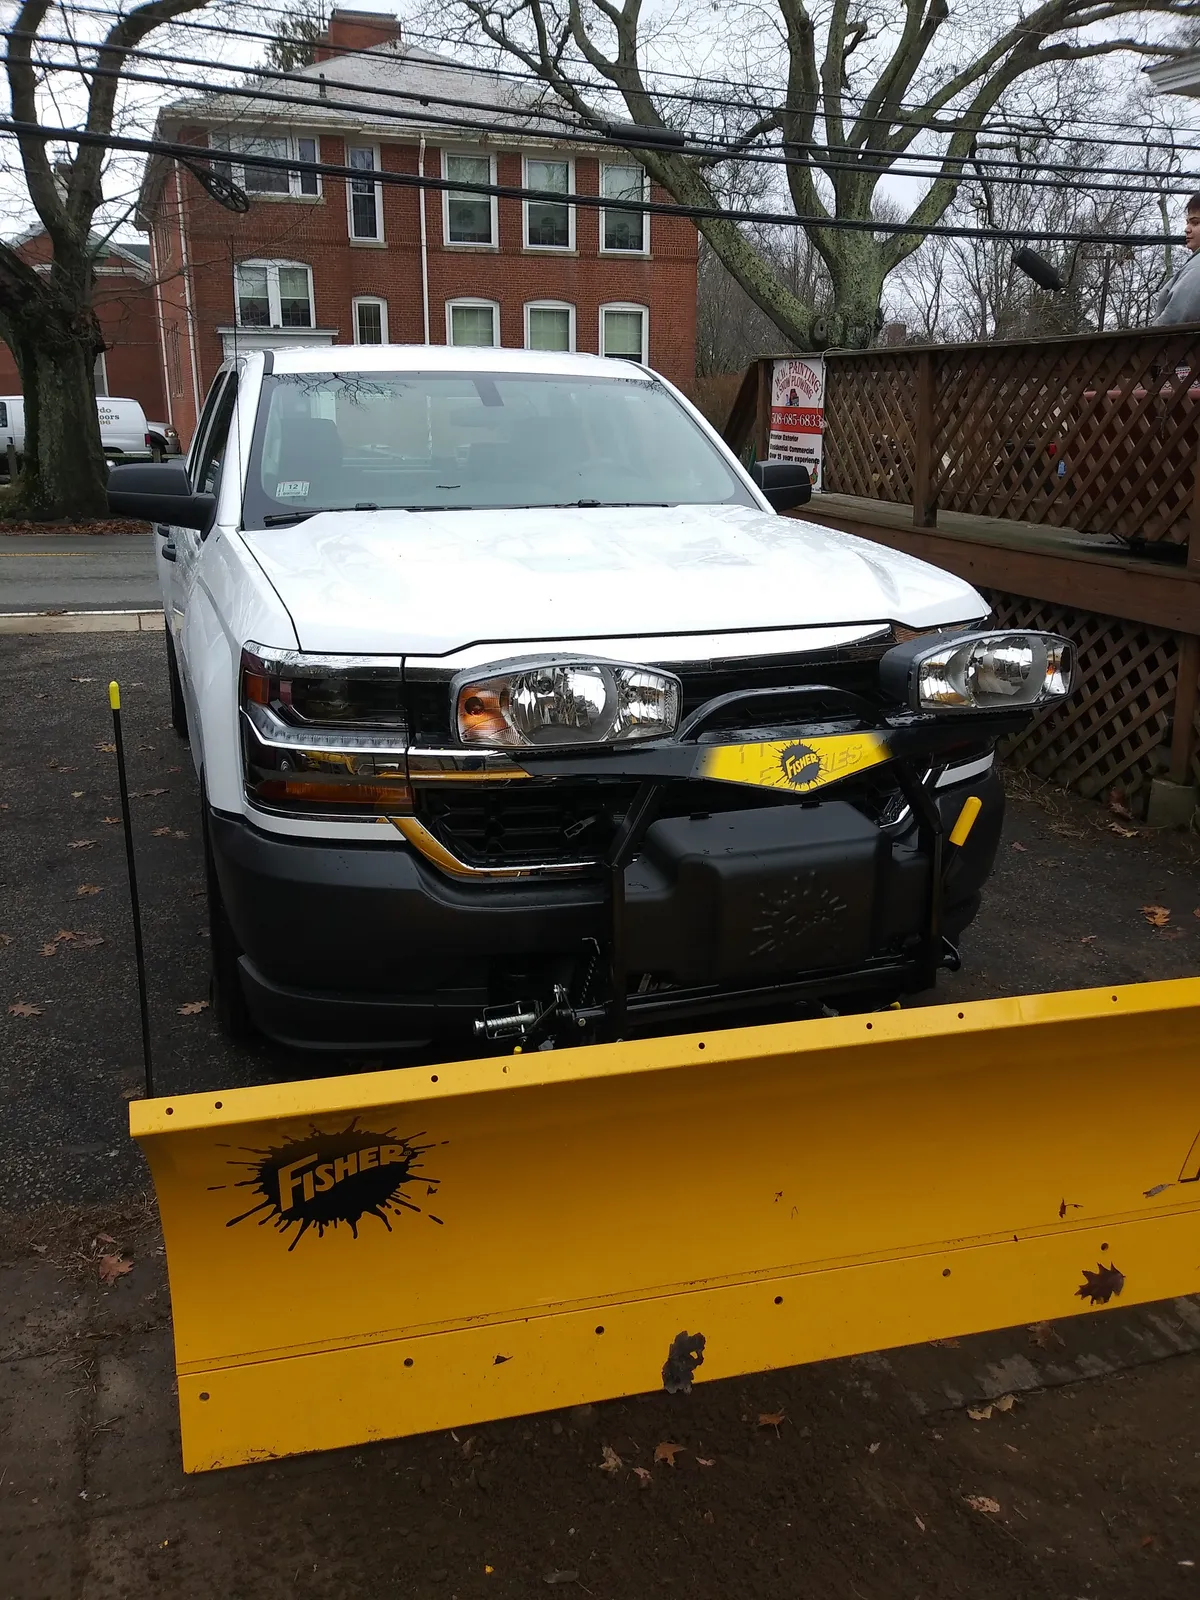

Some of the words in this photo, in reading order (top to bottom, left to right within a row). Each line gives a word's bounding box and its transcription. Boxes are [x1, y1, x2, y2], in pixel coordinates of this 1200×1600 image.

[788, 360, 821, 394] PAINTING
[791, 375, 814, 401] PLOWING
[97, 406, 112, 414] do
[771, 412, 822, 427] 508-685-6833
[782, 434, 799, 442] Exterior
[789, 445, 815, 455] Commercial
[782, 454, 794, 462] years
[794, 456, 820, 465] experience
[785, 752, 819, 779] FISHER
[277, 1144, 409, 1213] FISHER
